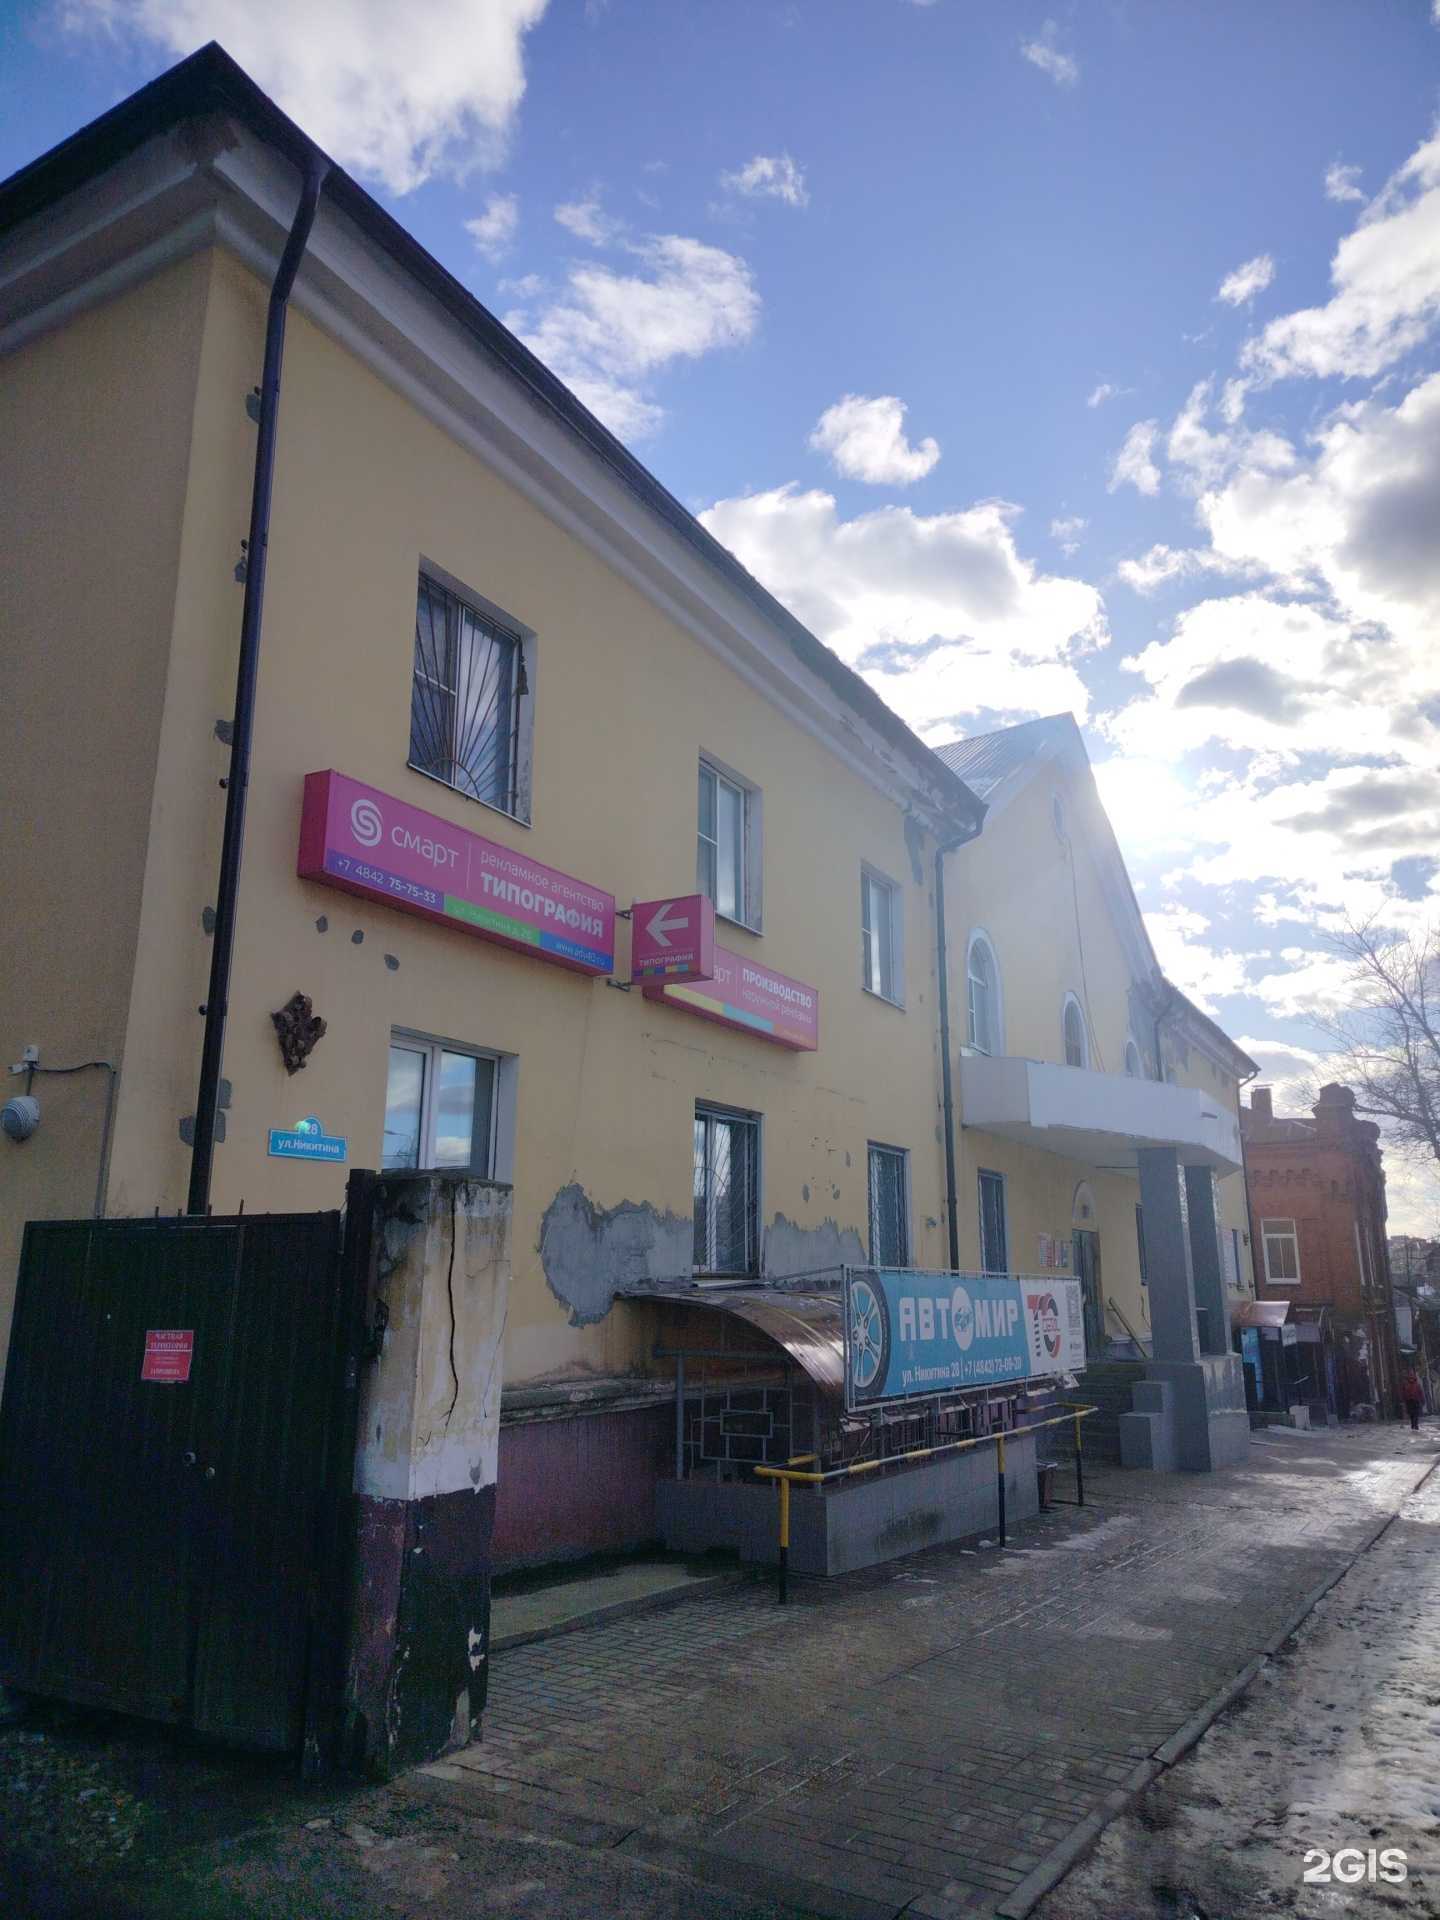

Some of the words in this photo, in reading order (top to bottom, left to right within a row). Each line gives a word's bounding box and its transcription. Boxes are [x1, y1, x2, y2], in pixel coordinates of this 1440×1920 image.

[391, 826, 460, 868] смарт
[338, 859, 351, 871] +7
[355, 865, 385, 884] 4842
[389, 877, 436, 904] 75-75-33
[480, 850, 549, 889] рекламное
[550, 878, 605, 914] агентство
[480, 872, 604, 938] ТИПОГРАФИЯ
[742, 967, 812, 1009] ПРОИЗВОДСТВО
